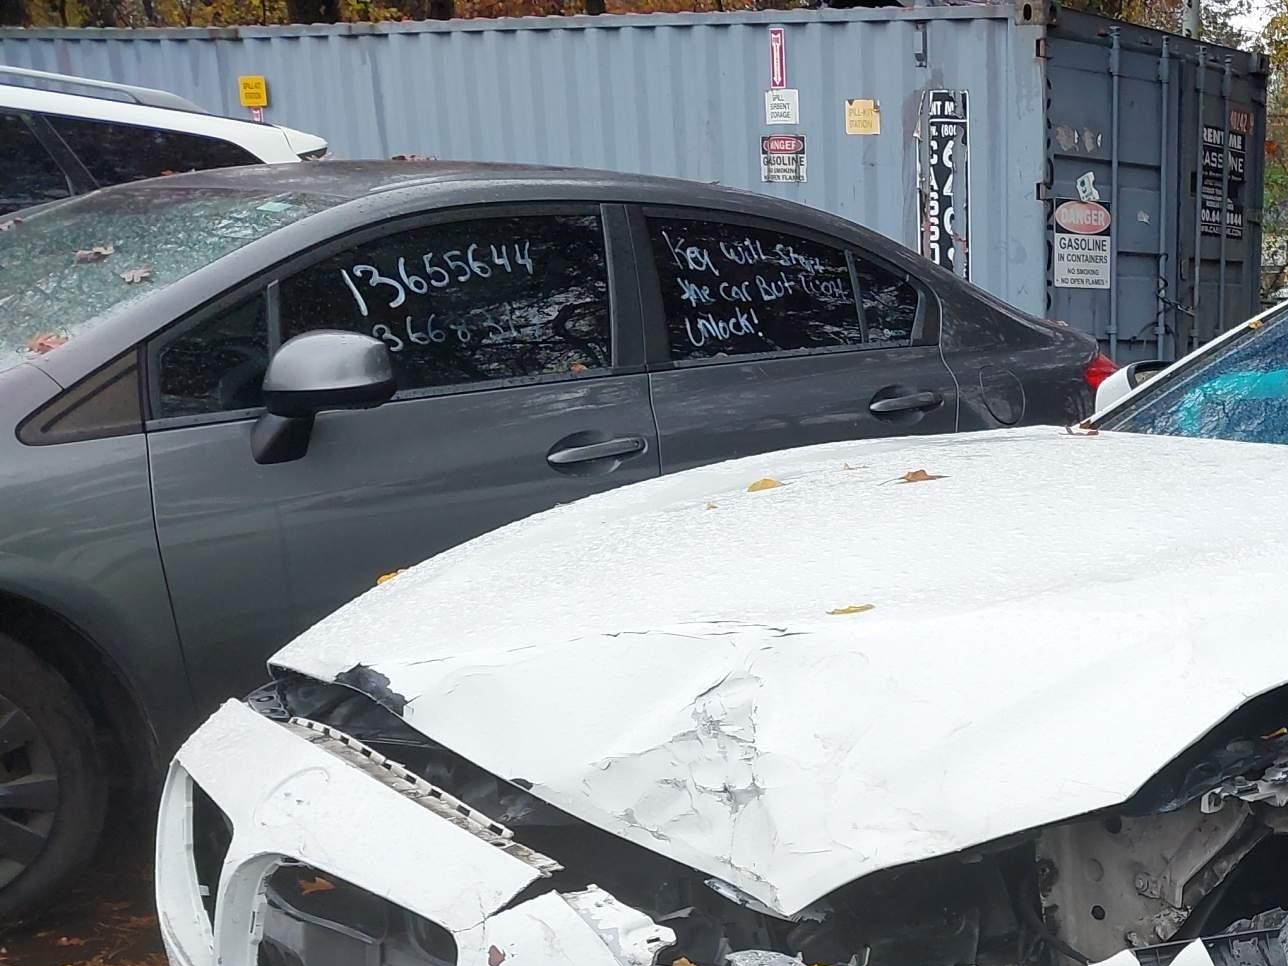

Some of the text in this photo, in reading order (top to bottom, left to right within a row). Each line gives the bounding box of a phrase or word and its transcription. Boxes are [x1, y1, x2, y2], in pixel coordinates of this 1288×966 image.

[1228, 133, 1242, 150] ME
[762, 155, 805, 168] GASOLINE
[1060, 207, 1106, 227] DANGER
[1059, 236, 1108, 252] GASOLINE
[661, 231, 720, 277] Key
[1057, 252, 1108, 265] IN CONTAINERS
[340, 240, 534, 316] 13655644
[1067, 267, 1100, 276] NO SMOKING
[1060, 277, 1105, 287] NO OPEN FLAMES
